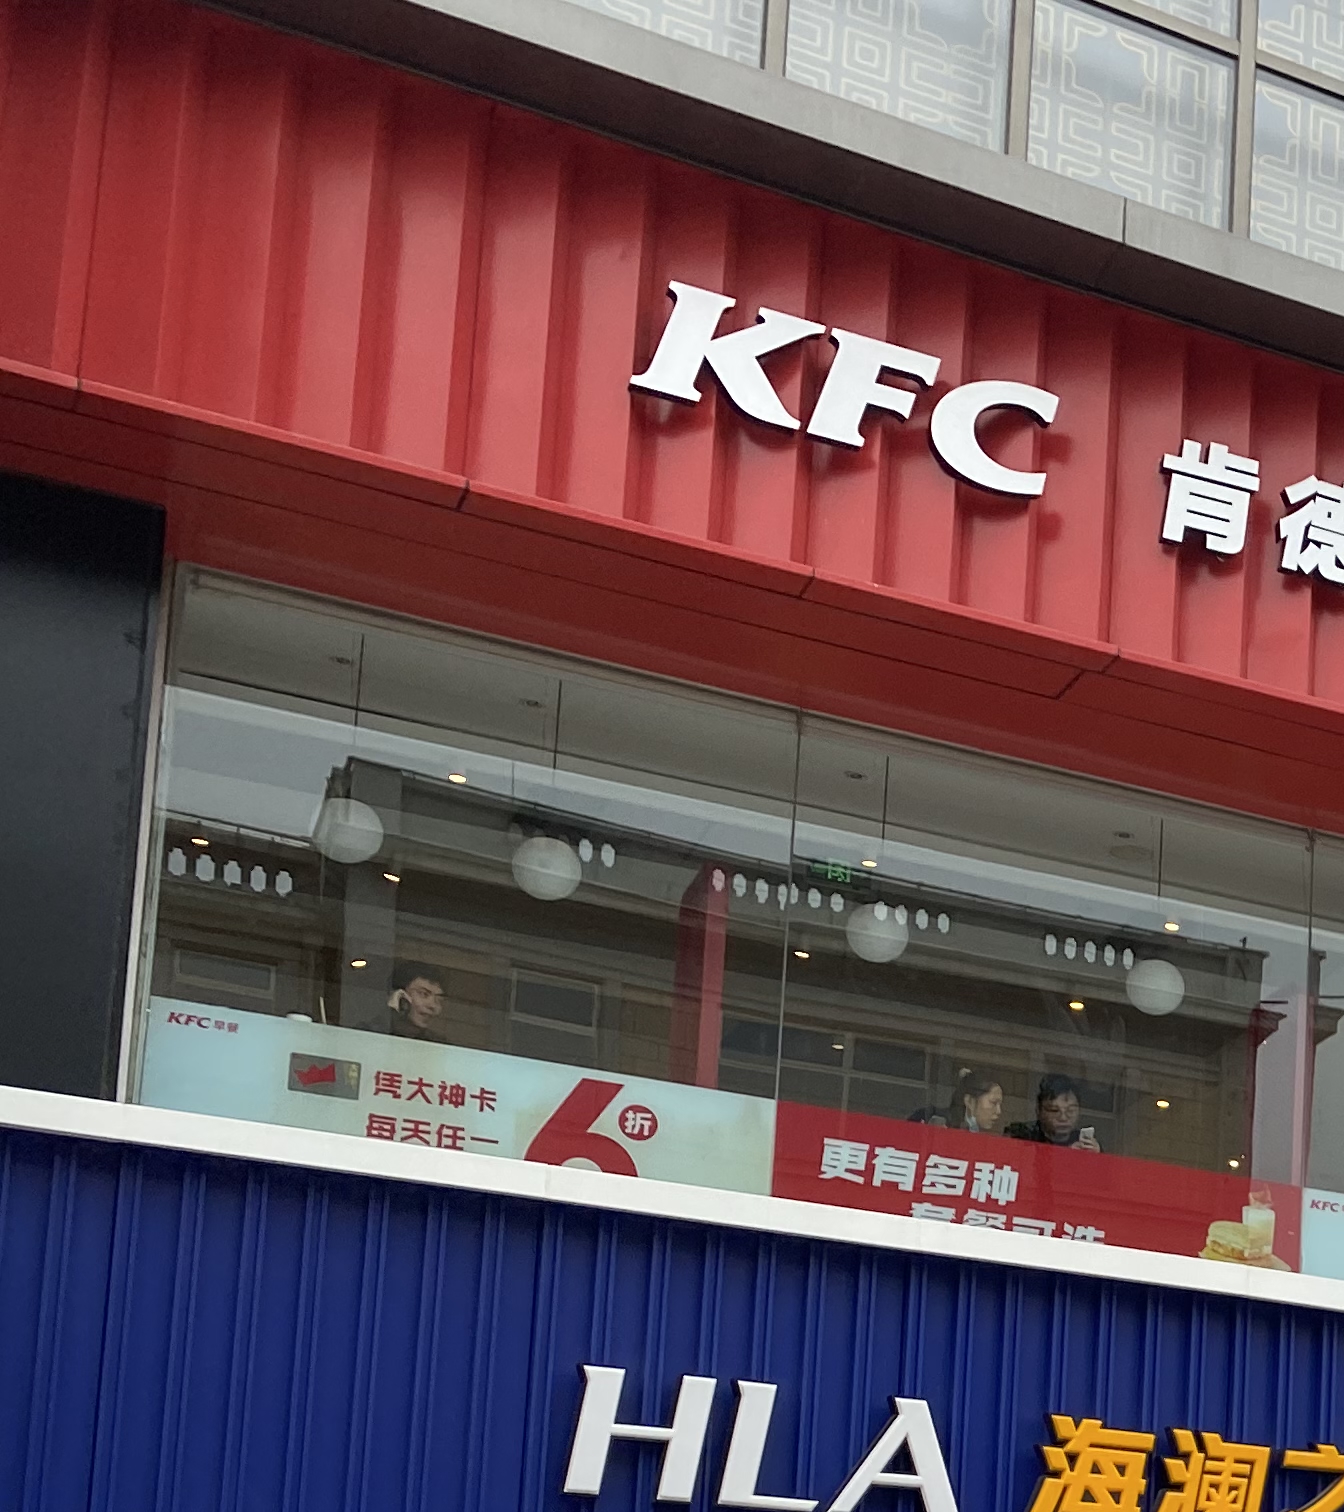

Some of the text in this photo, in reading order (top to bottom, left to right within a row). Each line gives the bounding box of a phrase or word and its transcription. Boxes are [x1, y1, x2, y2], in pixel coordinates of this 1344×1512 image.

[629, 280, 1059, 498] KFC
[167, 1011, 211, 1029] KFC
[373, 1070, 498, 1112] 凭大神卡
[365, 1113, 499, 1151] 每天任一
[624, 1110, 653, 1137] 折
[818, 1137, 1020, 1205] 更有多种
[1309, 1199, 1340, 1213] KFC
